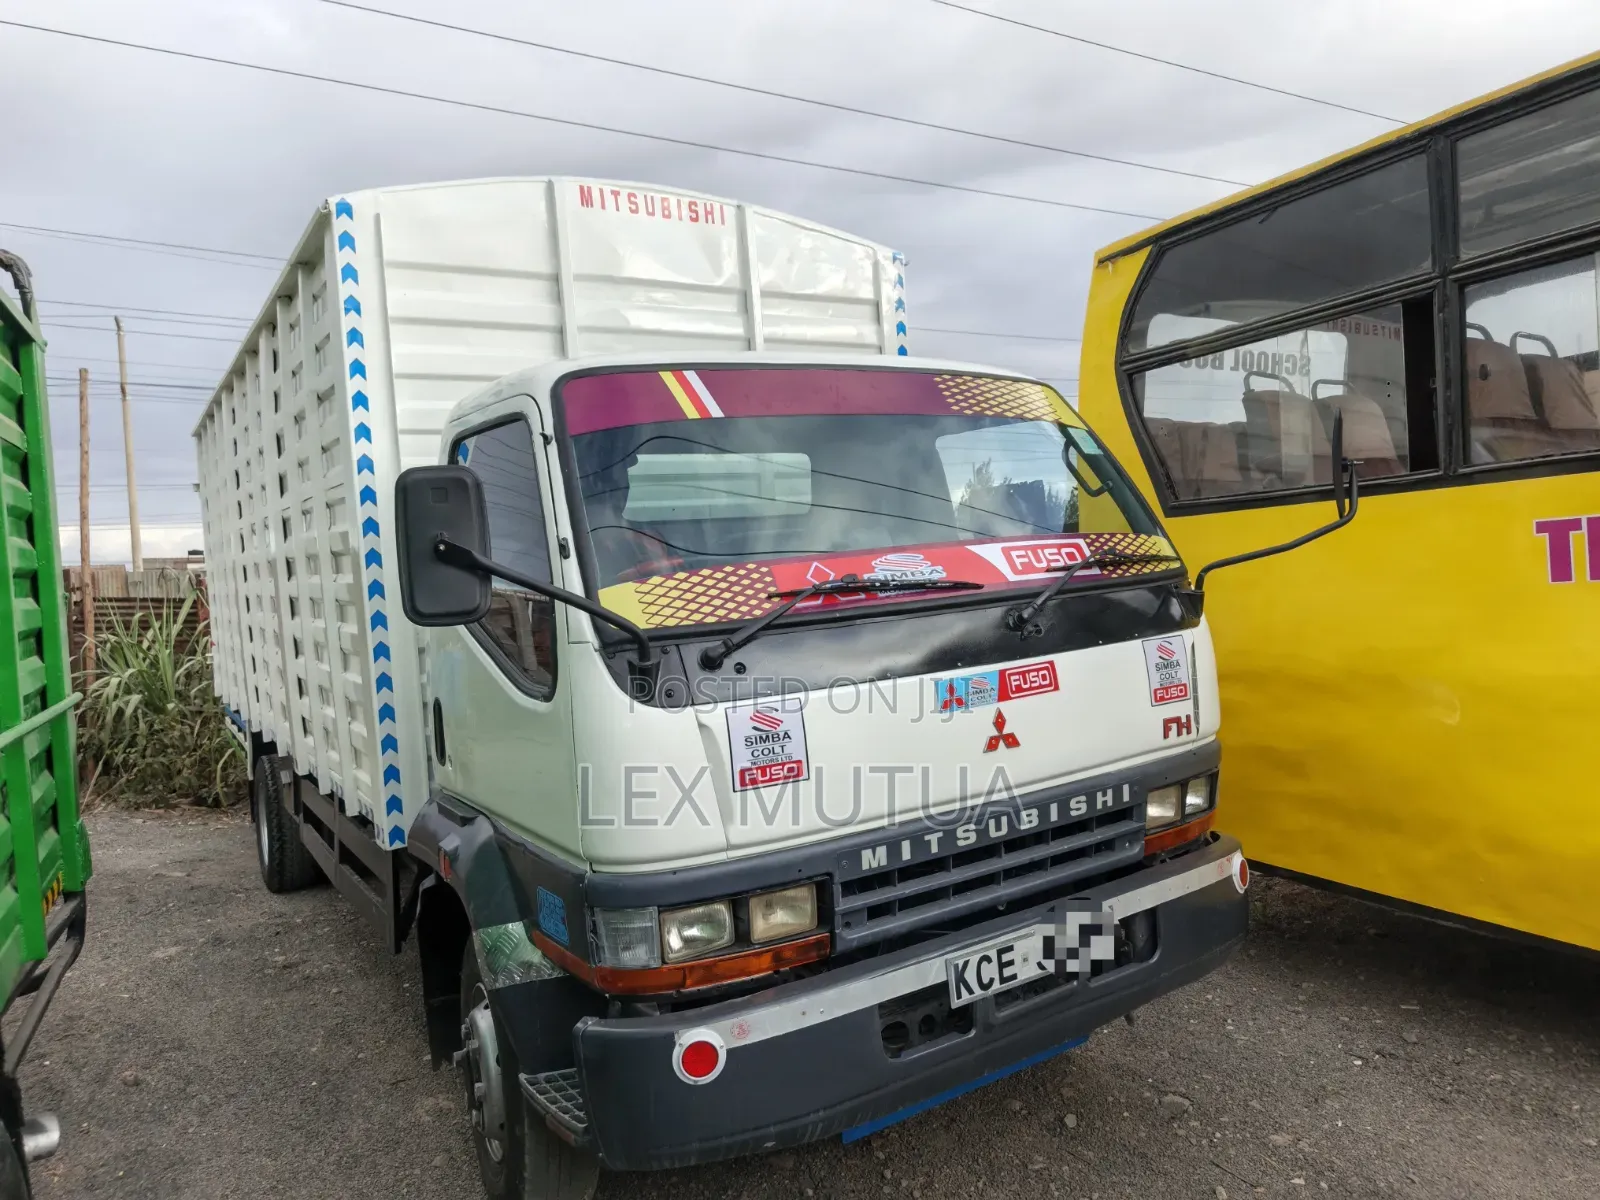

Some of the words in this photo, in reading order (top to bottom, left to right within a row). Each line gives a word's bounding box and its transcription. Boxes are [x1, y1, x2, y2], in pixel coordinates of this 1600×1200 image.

[578, 184, 726, 226] MITSUBISHI
[1011, 547, 1080, 570] FUSO
[866, 568, 943, 582] SIMBA
[1155, 661, 1181, 672] SIMBA
[1010, 670, 1050, 692] FUSO
[1160, 671, 1179, 681] COLT
[1156, 686, 1185, 701] FUSO
[1163, 714, 1193, 740] FH
[744, 731, 792, 747] SIMBA
[751, 745, 787, 758] COLT
[751, 757, 780, 767] MOTORS
[780, 755, 793, 763] LTD
[745, 763, 798, 784] FUSO
[861, 783, 1130, 871] MITSUBISHI
[953, 944, 1018, 1001] KCE
